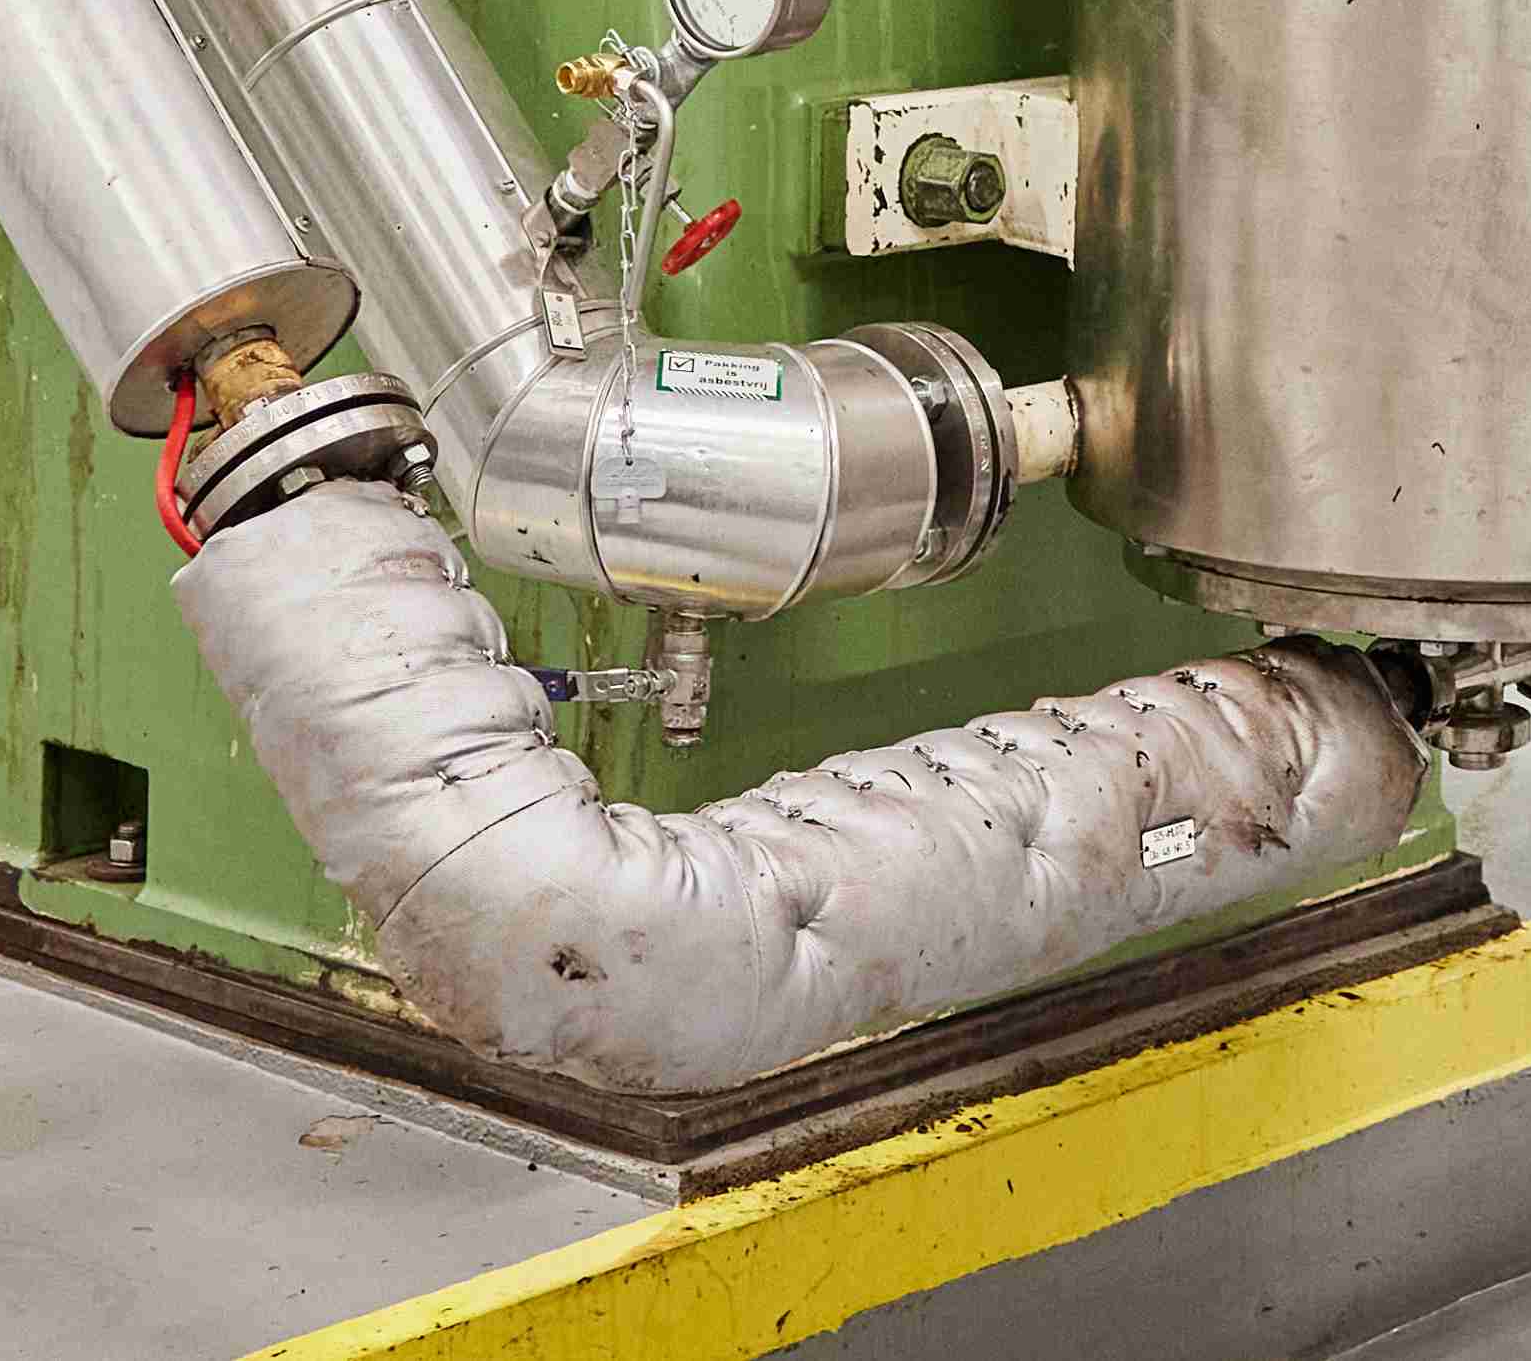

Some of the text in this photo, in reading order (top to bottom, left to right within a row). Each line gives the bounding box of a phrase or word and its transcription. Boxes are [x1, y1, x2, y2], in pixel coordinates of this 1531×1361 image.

[704, 359, 761, 373] Pakking
[725, 369, 738, 378] is
[698, 375, 768, 392] asbestvrij
